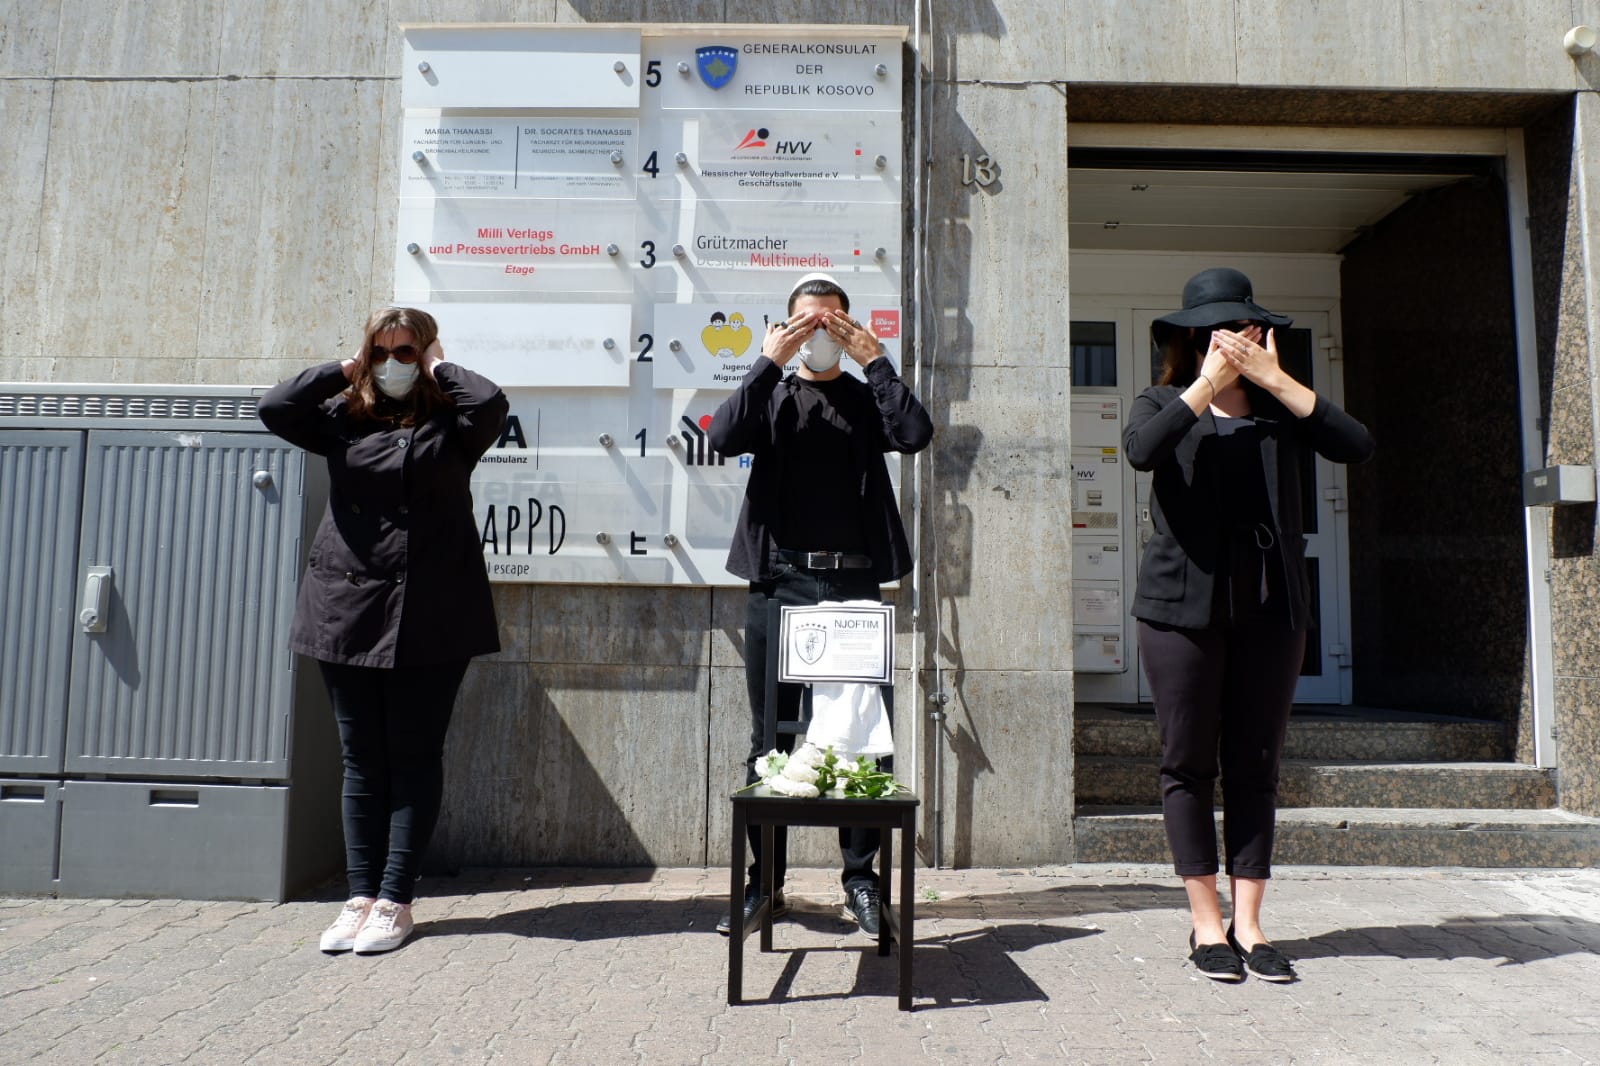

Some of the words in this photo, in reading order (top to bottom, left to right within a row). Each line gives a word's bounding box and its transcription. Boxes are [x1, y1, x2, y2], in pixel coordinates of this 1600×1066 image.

[743, 43, 877, 55] GENERALKONSULAT
[646, 60, 662, 87] 5
[796, 64, 823, 75] DER
[745, 85, 810, 96] REPUBLIK
[817, 85, 874, 97] KOSOVO
[540, 128, 584, 136] SOCRATES
[586, 128, 632, 136] THANASSIS
[775, 141, 813, 154] HVV
[642, 150, 660, 178] 4
[962, 153, 996, 186] 13
[701, 169, 747, 178] Hessischer
[749, 169, 823, 179] Volleyballverband
[738, 179, 803, 188] Geschäftsstelle
[477, 228, 503, 239] Milli
[506, 228, 554, 241] Verlags
[429, 243, 451, 254] und
[456, 244, 556, 255] Pressevertriebs
[559, 244, 600, 255] GmbH
[697, 235, 788, 250] Grützmacher
[640, 240, 656, 269] 3
[749, 252, 835, 268] Multimedia.
[504, 264, 535, 275] Etage
[636, 333, 654, 363] 2
[634, 428, 647, 458] 1
[481, 497, 566, 555] APPD
[494, 563, 530, 577] escape
[834, 619, 879, 629] NJOFTIM
